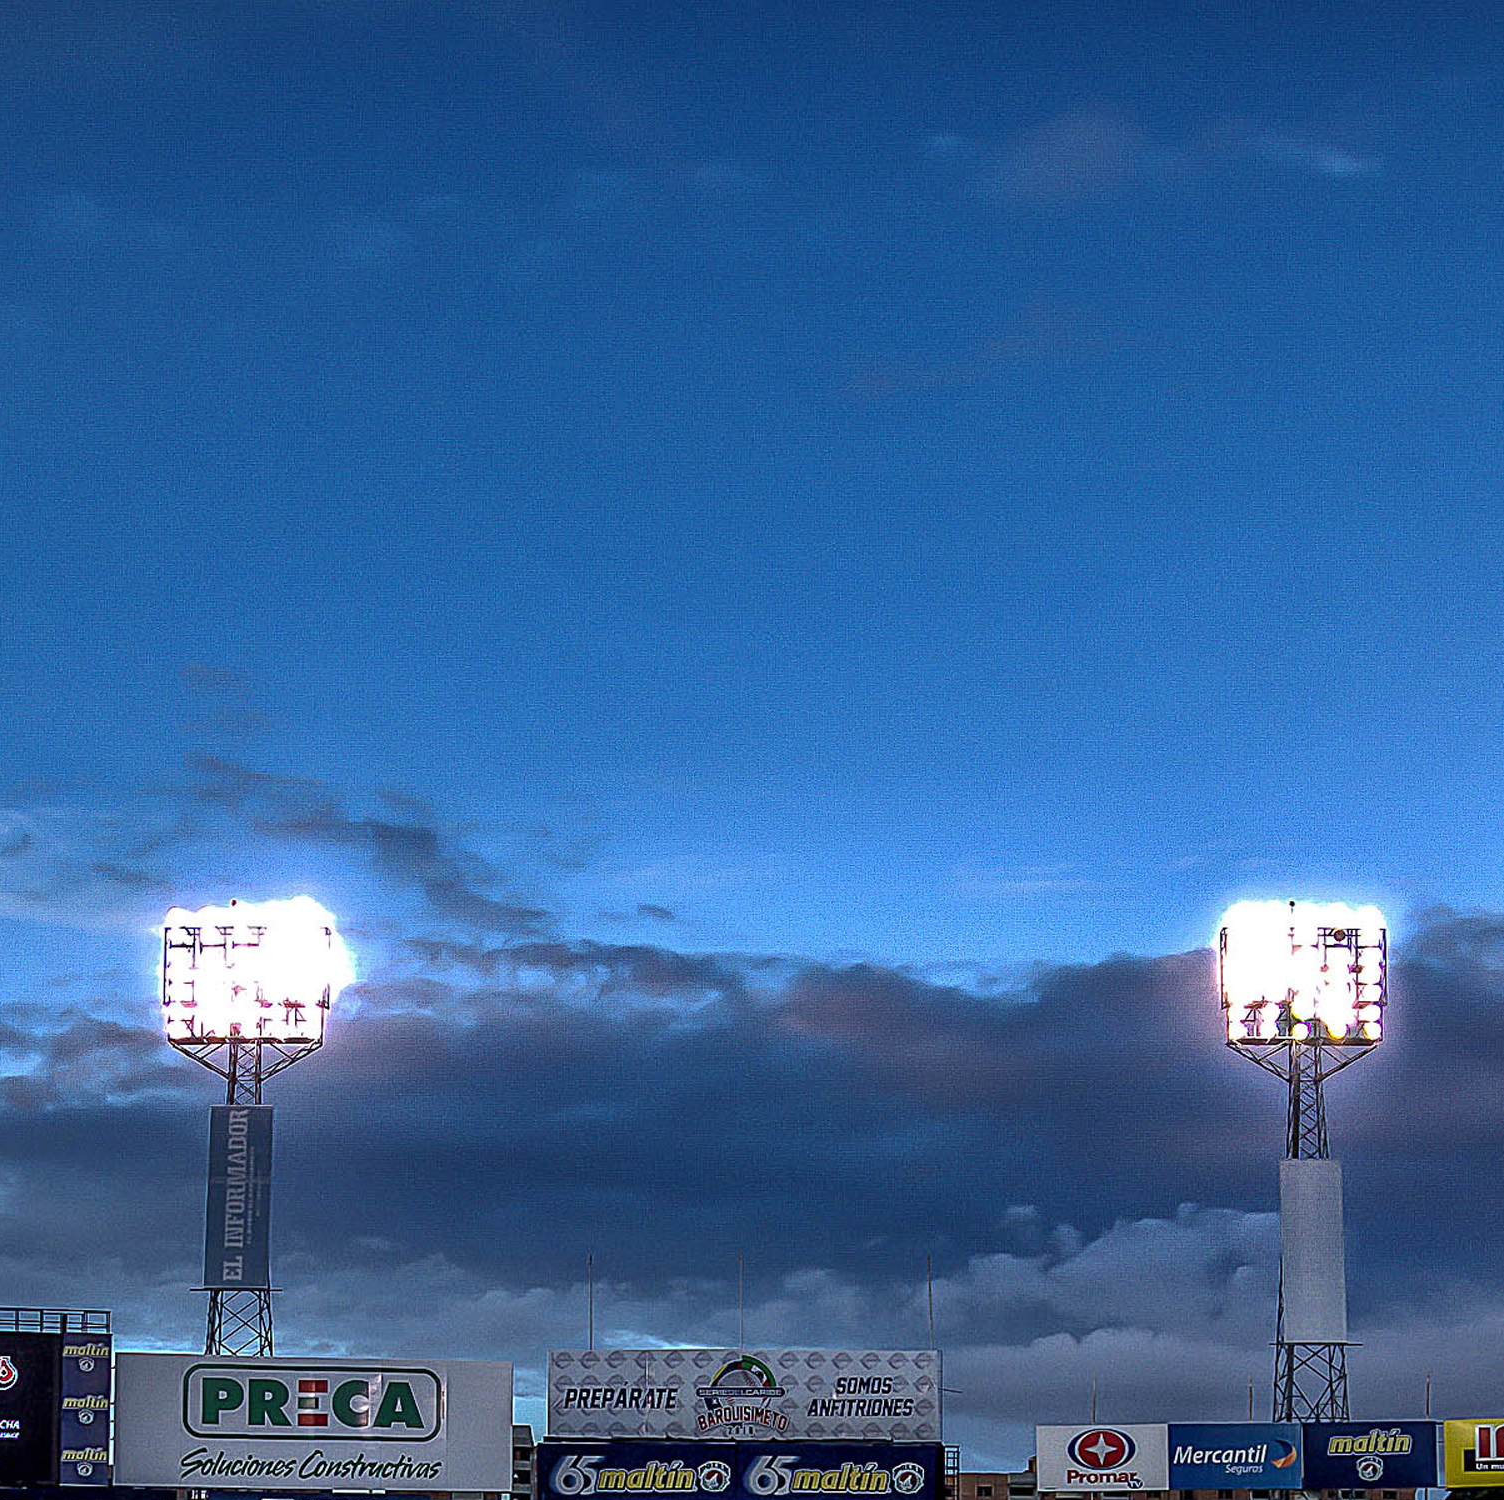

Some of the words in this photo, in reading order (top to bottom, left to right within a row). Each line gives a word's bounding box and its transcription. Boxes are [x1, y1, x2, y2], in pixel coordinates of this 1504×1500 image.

[225, 1109, 248, 1248] INFORMADOR
[223, 1255, 243, 1281] EL
[62, 1342, 109, 1357] maltín
[563, 1381, 678, 1410] PREPÁRATE
[836, 1377, 893, 1395] SOMOS
[62, 1395, 108, 1410] maltín
[201, 1377, 425, 1429] PRECA
[807, 1398, 915, 1418] ANFITRIONES
[697, 1405, 789, 1431] BARQUISIMETO
[61, 1447, 107, 1462] maltín
[1173, 1443, 1267, 1466] Mercantil
[1327, 1428, 1412, 1456] maltín
[180, 1447, 297, 1480] Soluciones
[298, 1450, 442, 1480] Constructivas
[550, 1455, 605, 1496] 65
[597, 1461, 696, 1493] maltín
[743, 1455, 801, 1496] 65
[791, 1462, 891, 1494] maltín
[1225, 1463, 1264, 1475] Seguros
[1067, 1470, 1136, 1485] Promar
